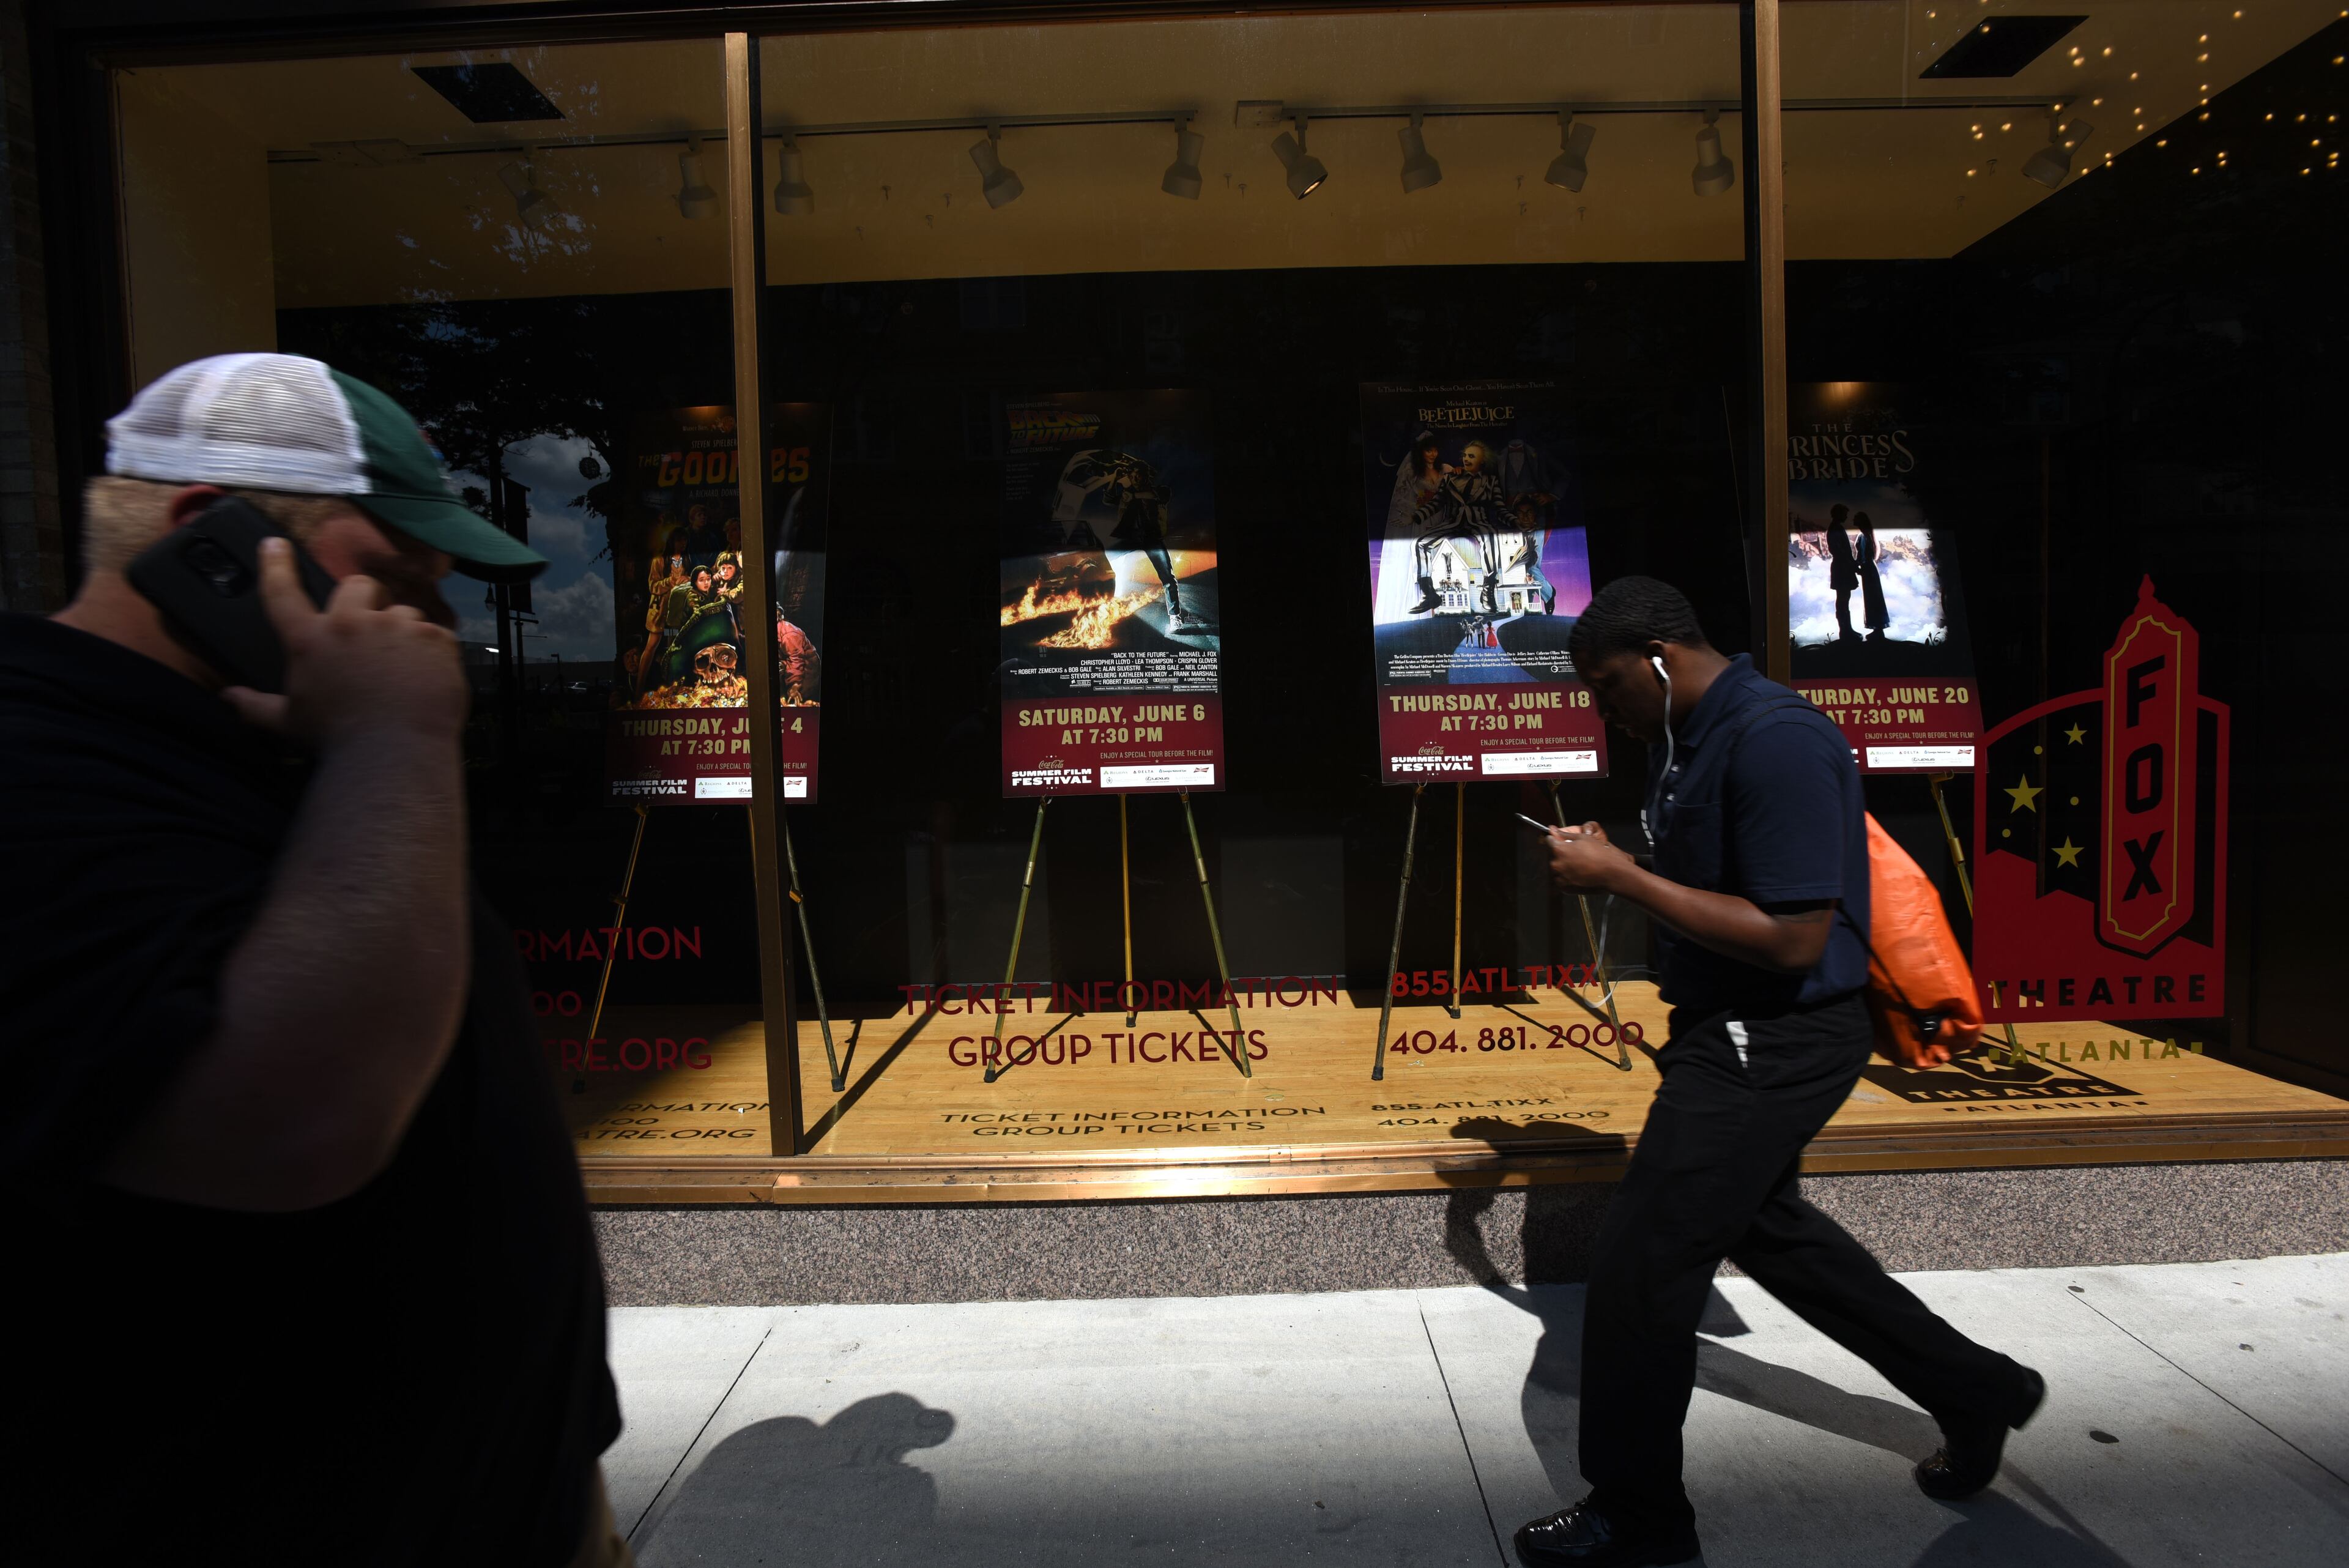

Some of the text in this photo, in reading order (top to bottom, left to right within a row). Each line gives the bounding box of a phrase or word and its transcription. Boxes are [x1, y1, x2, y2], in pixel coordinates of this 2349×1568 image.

[1419, 406, 1515, 422] BEETLEJUICE
[1811, 423, 1852, 433] THE
[691, 439, 738, 448] STEVEN SPIELBER
[1789, 430, 1915, 474] RINCESS
[637, 455, 659, 468] THE
[1788, 457, 1888, 480] BRIDE
[721, 489, 739, 497] DONNE
[1390, 691, 1590, 712] THURSDAY, JUNE 18
[1797, 687, 1969, 706] TURDAY, JUNE 20
[1019, 704, 1205, 727] SATURDAY, JUNE 6
[1441, 714, 1543, 731] AT 7:30 PM
[1852, 708, 1891, 724] 7:30
[1897, 708, 1924, 723] PM
[622, 718, 725, 737] THURSDAY,
[791, 717, 803, 734] 4
[1061, 727, 1162, 745] AT 7:30 PM
[661, 740, 682, 756] AT
[688, 740, 725, 755] 7:30
[1392, 762, 1474, 772] FESTIVAL
[1012, 776, 1092, 786] FESTIVAL
[2123, 655, 2165, 902] FOX
[612, 786, 687, 795] FESTIVAL
[513, 925, 703, 962] RMATION
[1390, 963, 1598, 998] 855.ATL.TIXX
[897, 976, 1338, 1016] TICKET INFORMATION
[1987, 973, 2206, 1010] THEATRE
[1390, 1021, 1644, 1055] 404. 881. 2000
[948, 1030, 1269, 1068] GROUP TICKETS
[2008, 1038, 2181, 1065] ATLANTA
[941, 1106, 1326, 1123] TICKET INFORMATION
[973, 1121, 1266, 1136] GROUP TICKETS
